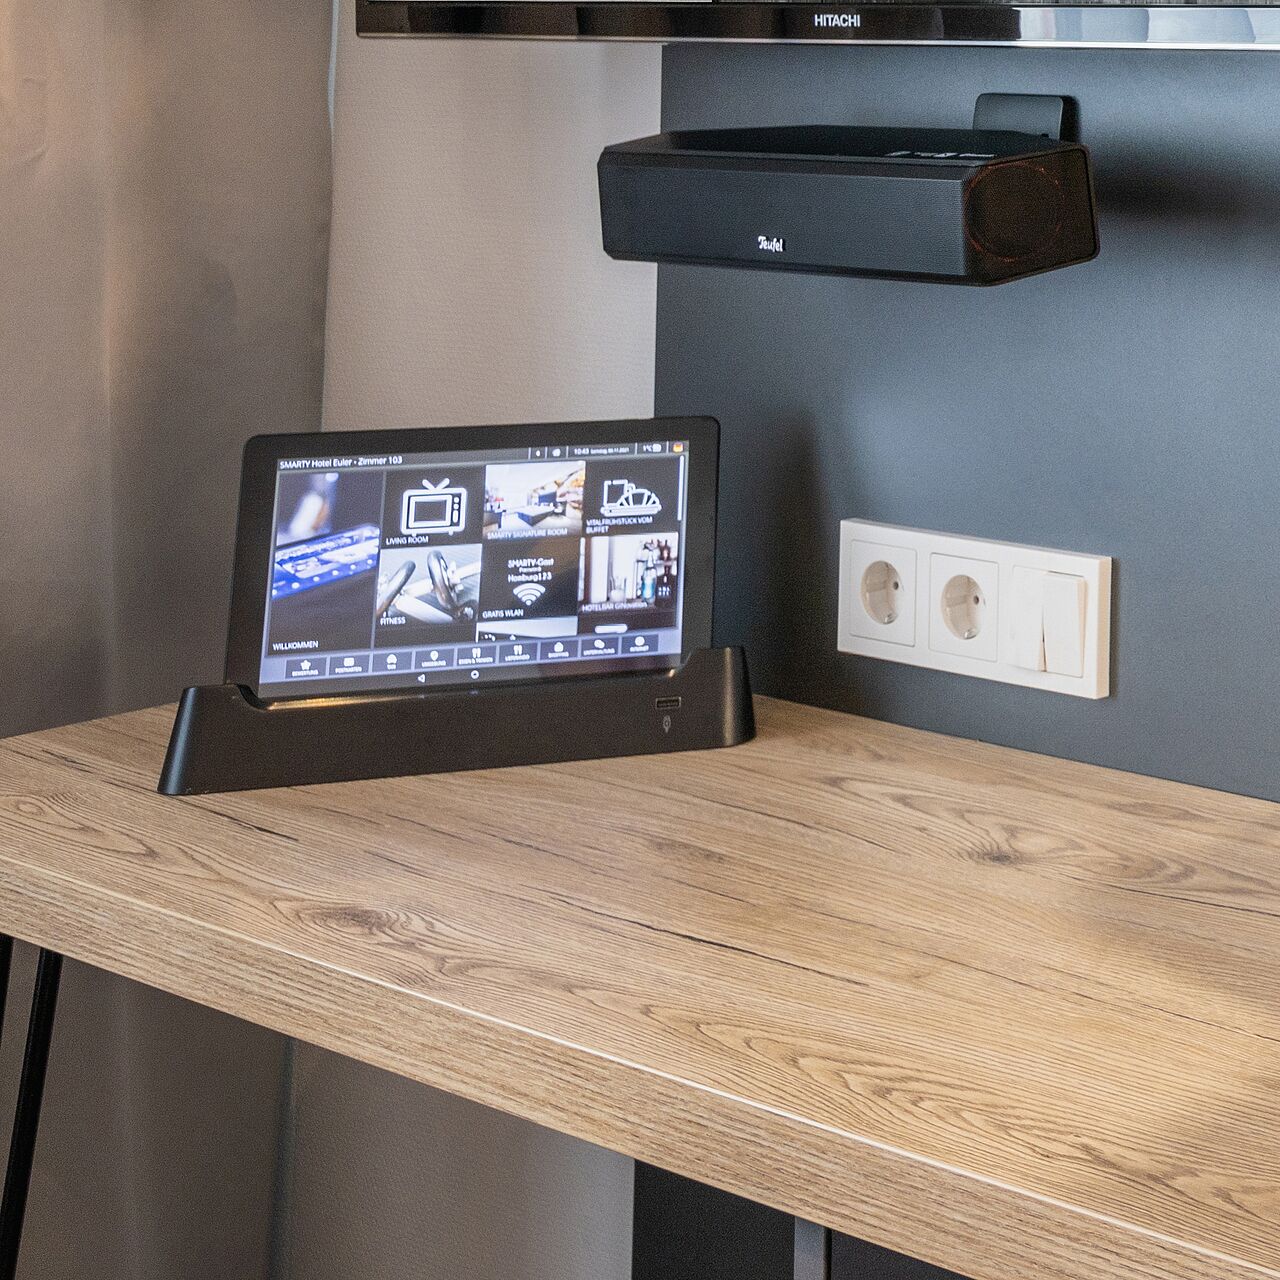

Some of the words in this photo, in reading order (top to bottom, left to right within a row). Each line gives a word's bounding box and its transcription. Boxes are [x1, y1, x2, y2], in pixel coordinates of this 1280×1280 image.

[815, 14, 860, 27] HITACHI
[758, 235, 783, 252] Teufel
[280, 459, 311, 470] SMARTY
[312, 458, 332, 468] Hotel
[333, 458, 353, 467] Euler
[358, 457, 387, 466] Zimmer
[388, 455, 403, 465] 103
[547, 528, 567, 537] ROOM
[385, 537, 407, 545] LIVING
[408, 535, 429, 544] ROOM
[482, 609, 504, 618] GRATIS
[504, 608, 523, 617] WLAN
[380, 616, 406, 625] FITNESS
[273, 640, 319, 651] WILLKOMMEN
